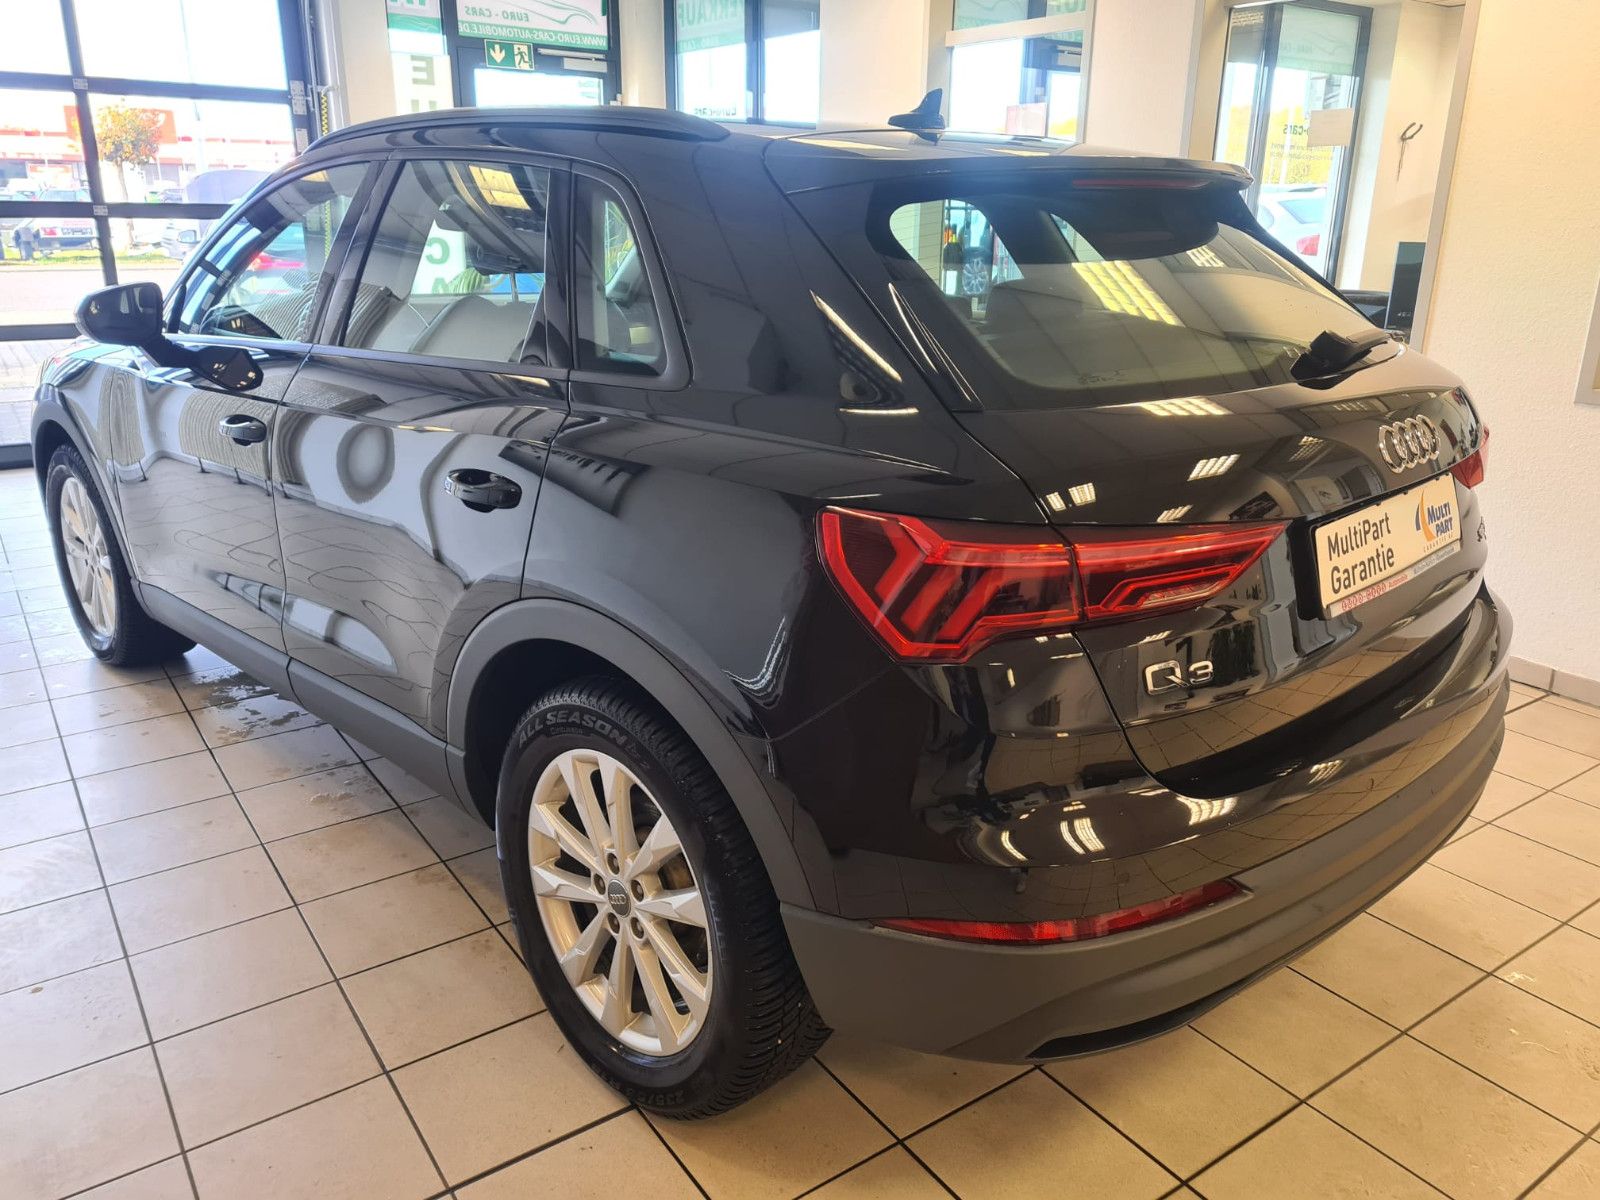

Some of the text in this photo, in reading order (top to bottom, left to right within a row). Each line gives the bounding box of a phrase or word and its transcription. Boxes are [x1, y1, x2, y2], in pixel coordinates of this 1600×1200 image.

[1427, 502, 1451, 525] MULTI
[1435, 516, 1453, 538] PART
[1327, 512, 1392, 562] MultiPart
[1330, 544, 1395, 595] Garantie
[1142, 660, 1214, 696] Q3
[519, 709, 628, 747] ALL SEASON
